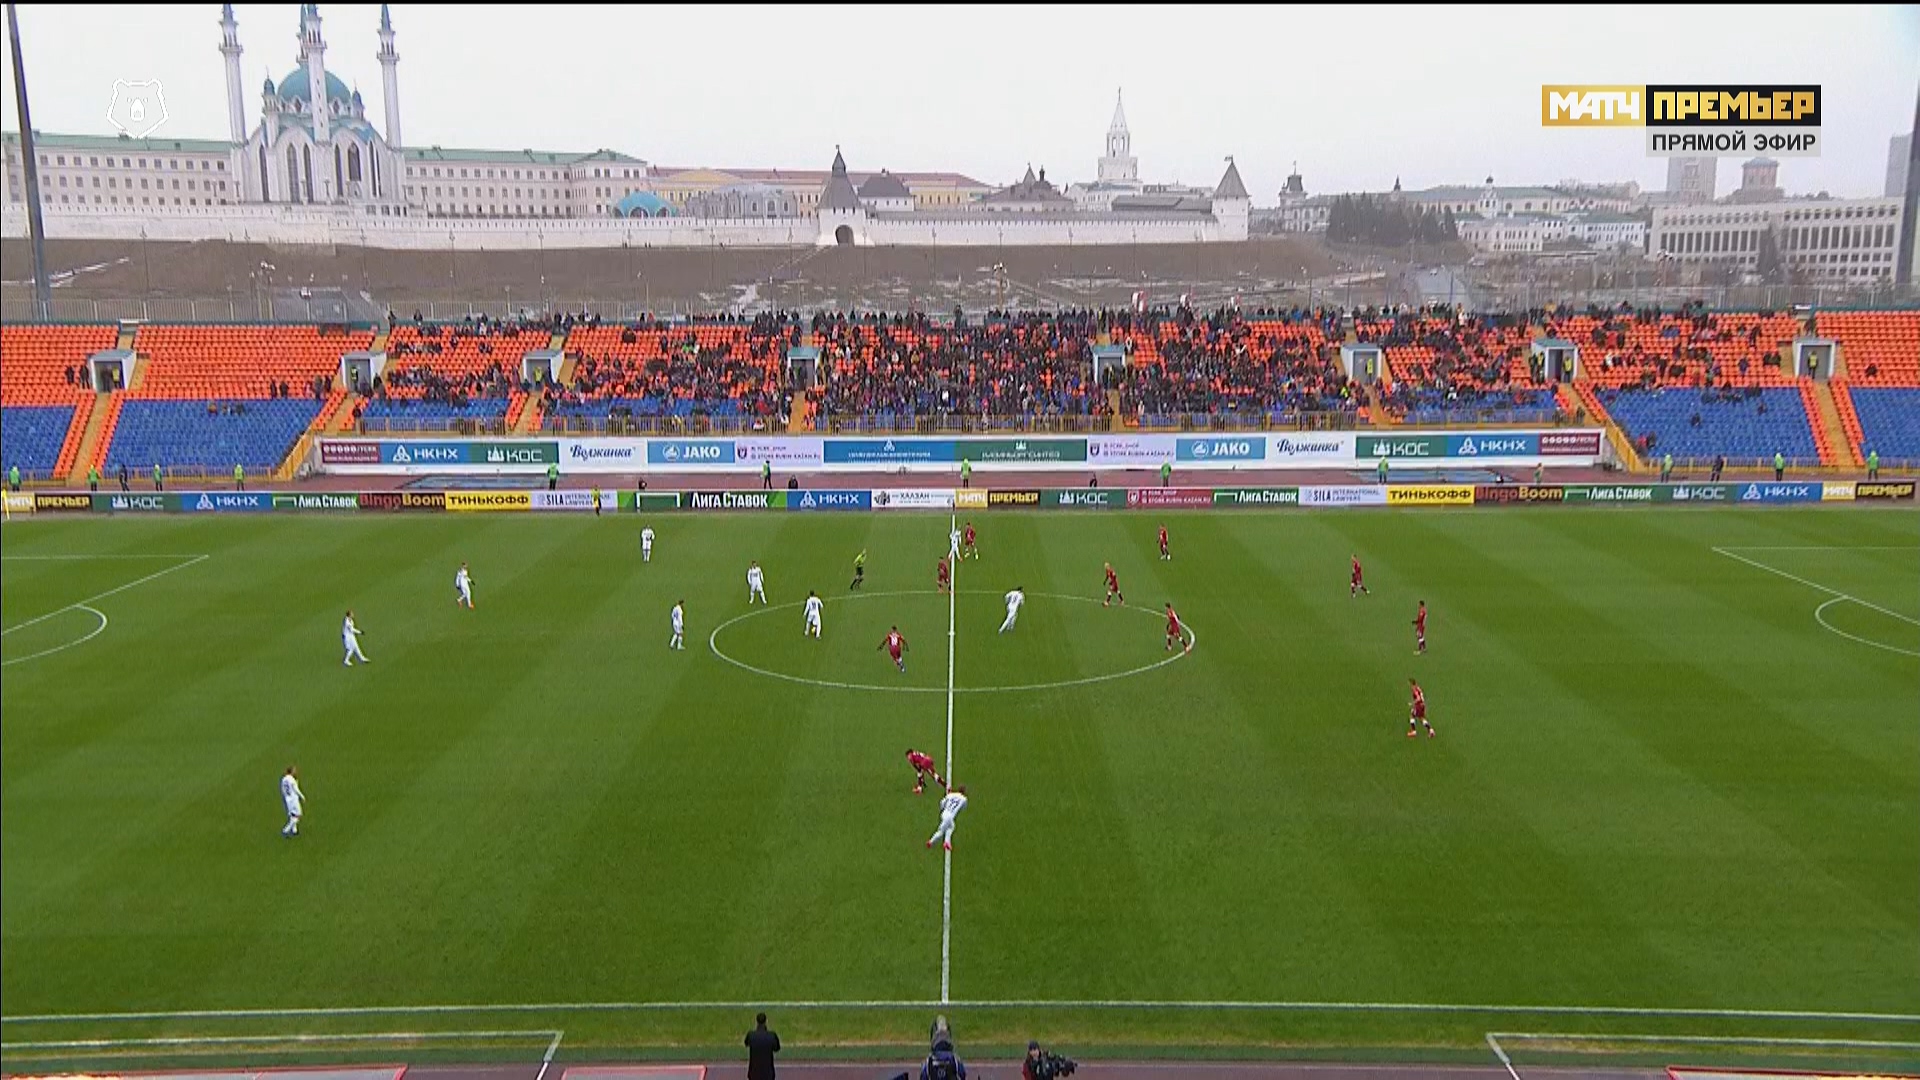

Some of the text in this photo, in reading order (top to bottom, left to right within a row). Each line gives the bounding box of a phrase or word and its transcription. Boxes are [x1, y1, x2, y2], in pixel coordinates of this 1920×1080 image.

[683, 446, 721, 459] JAKO
[1211, 442, 1250, 456] JAKO
[450, 495, 529, 505] ТИНЬКОФФ
[546, 494, 564, 506] SILA
[989, 492, 1039, 504] ПРЕМЬЕР
[1313, 490, 1331, 501] SILA
[1389, 490, 1471, 500] ТИНЬКОФФ
[37, 496, 90, 507] ПРЕМЬЕР
